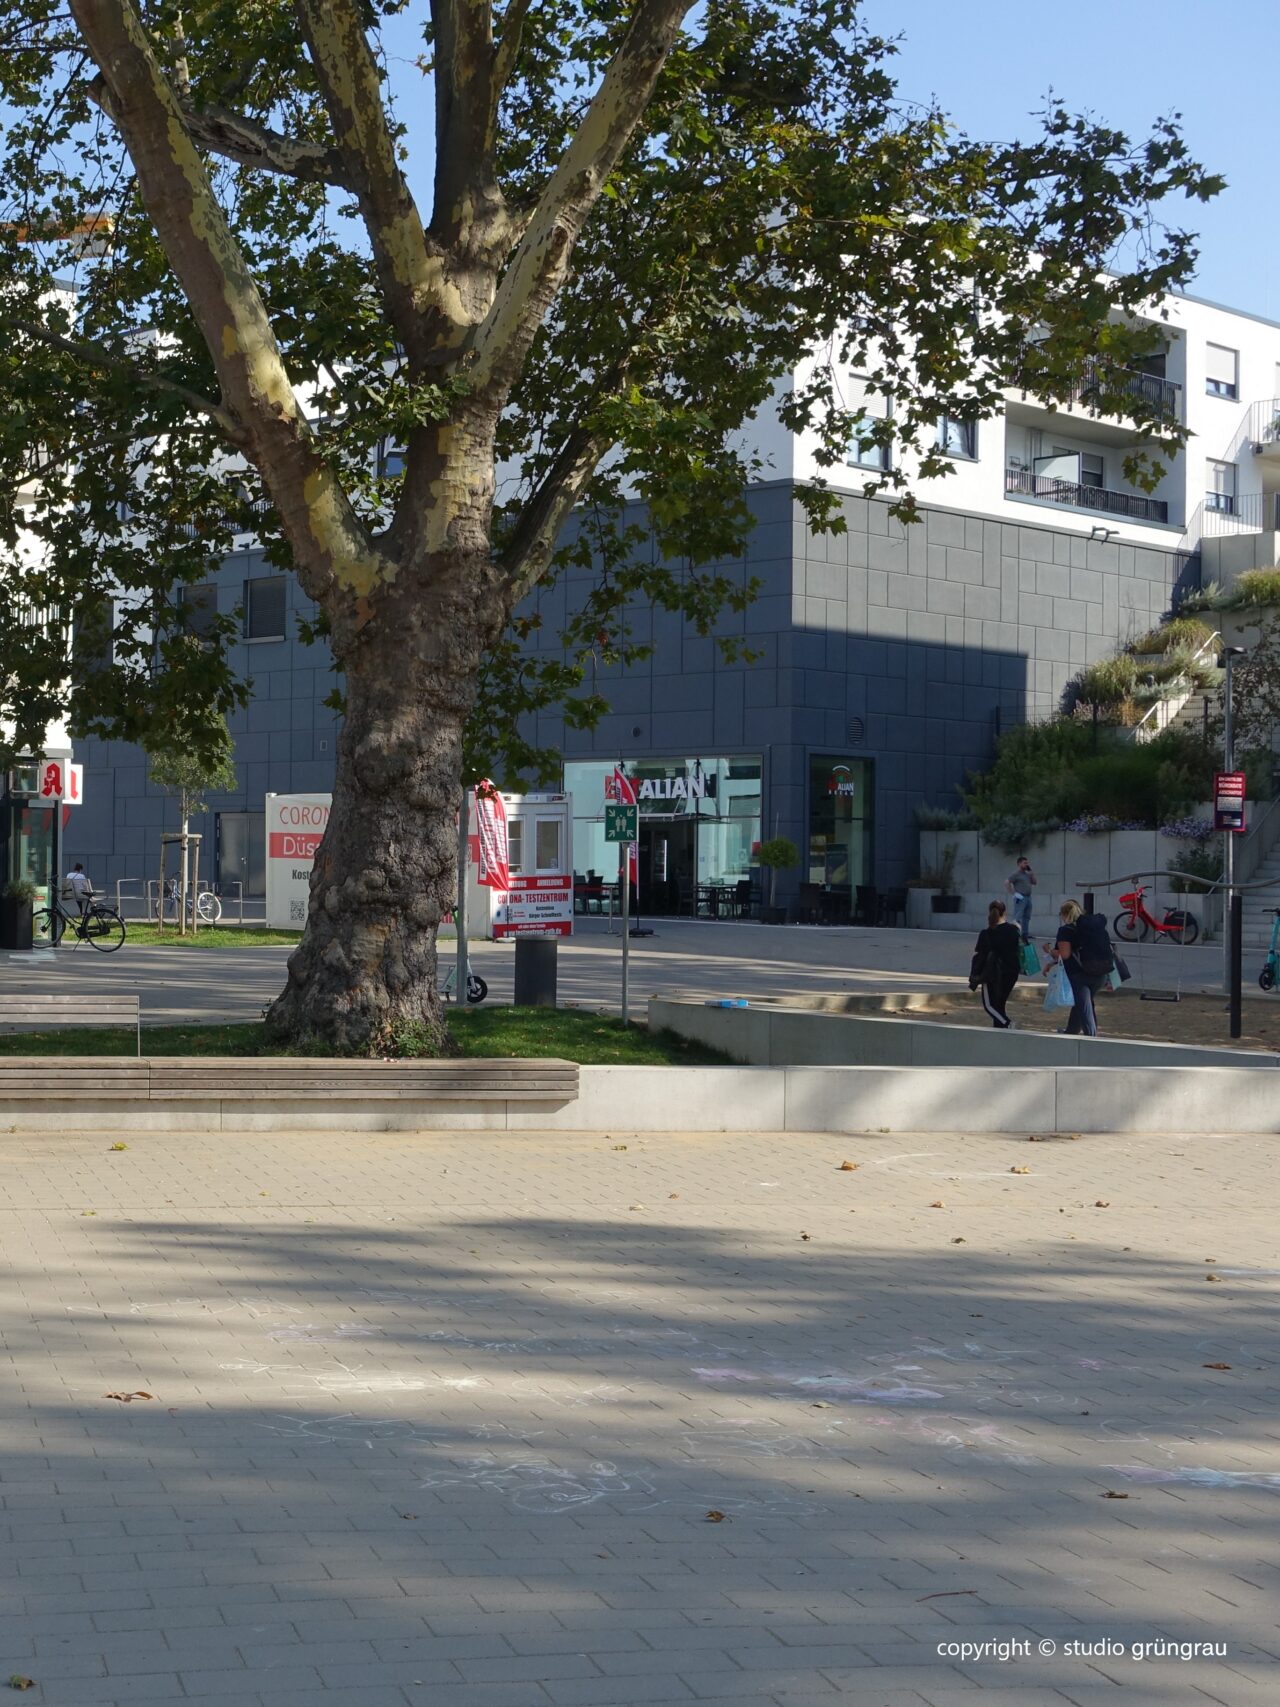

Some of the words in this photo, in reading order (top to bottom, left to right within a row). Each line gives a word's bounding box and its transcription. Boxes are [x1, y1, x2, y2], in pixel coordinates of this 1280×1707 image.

[279, 806, 331, 825] CORON
[498, 894, 525, 904] COONA-
[525, 892, 569, 903] TESTZENTRUM
